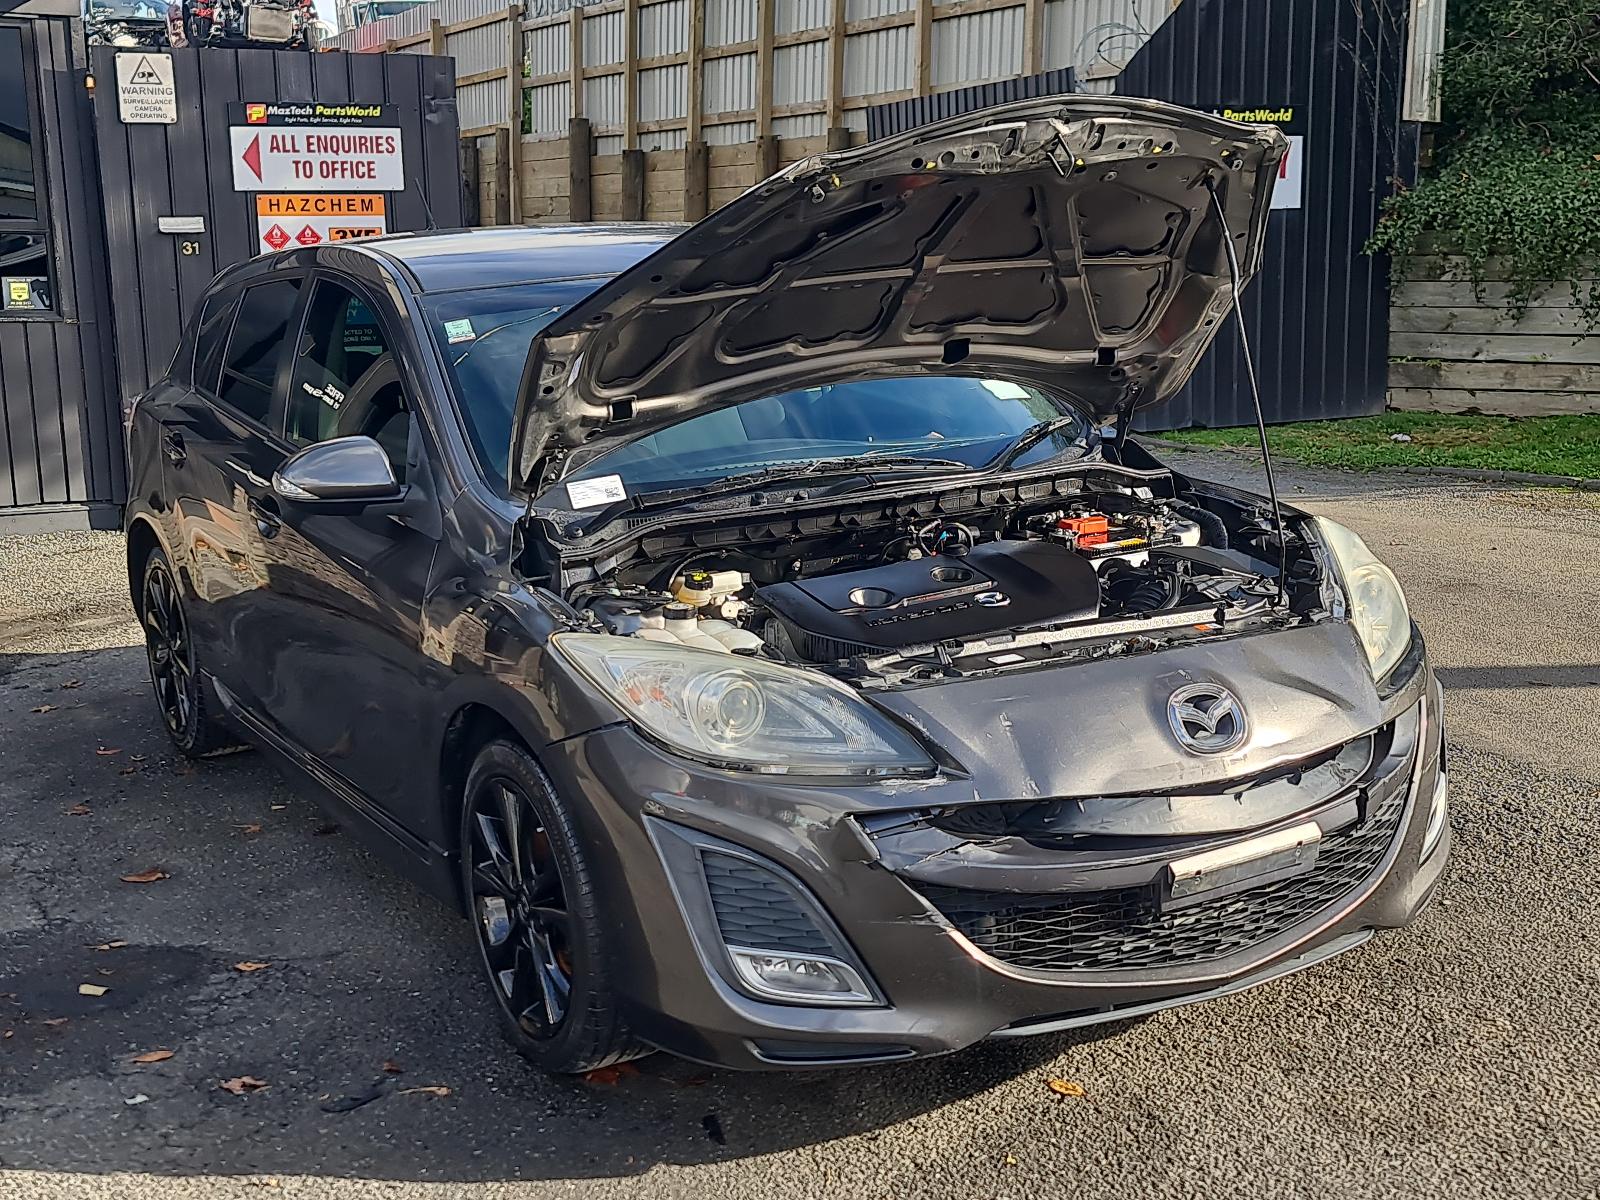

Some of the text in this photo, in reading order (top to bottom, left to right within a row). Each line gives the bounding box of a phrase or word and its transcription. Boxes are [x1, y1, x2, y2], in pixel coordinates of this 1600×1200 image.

[121, 87, 174, 96] WARNING
[267, 105, 381, 117] MazTech PartsWorld
[1223, 108, 1293, 121] PartsWorld
[269, 134, 396, 155] ALL ENQUIRIES
[292, 160, 377, 179] TO OFFICE
[268, 198, 374, 212] HAZCHEM
[182, 241, 200, 255] 31
